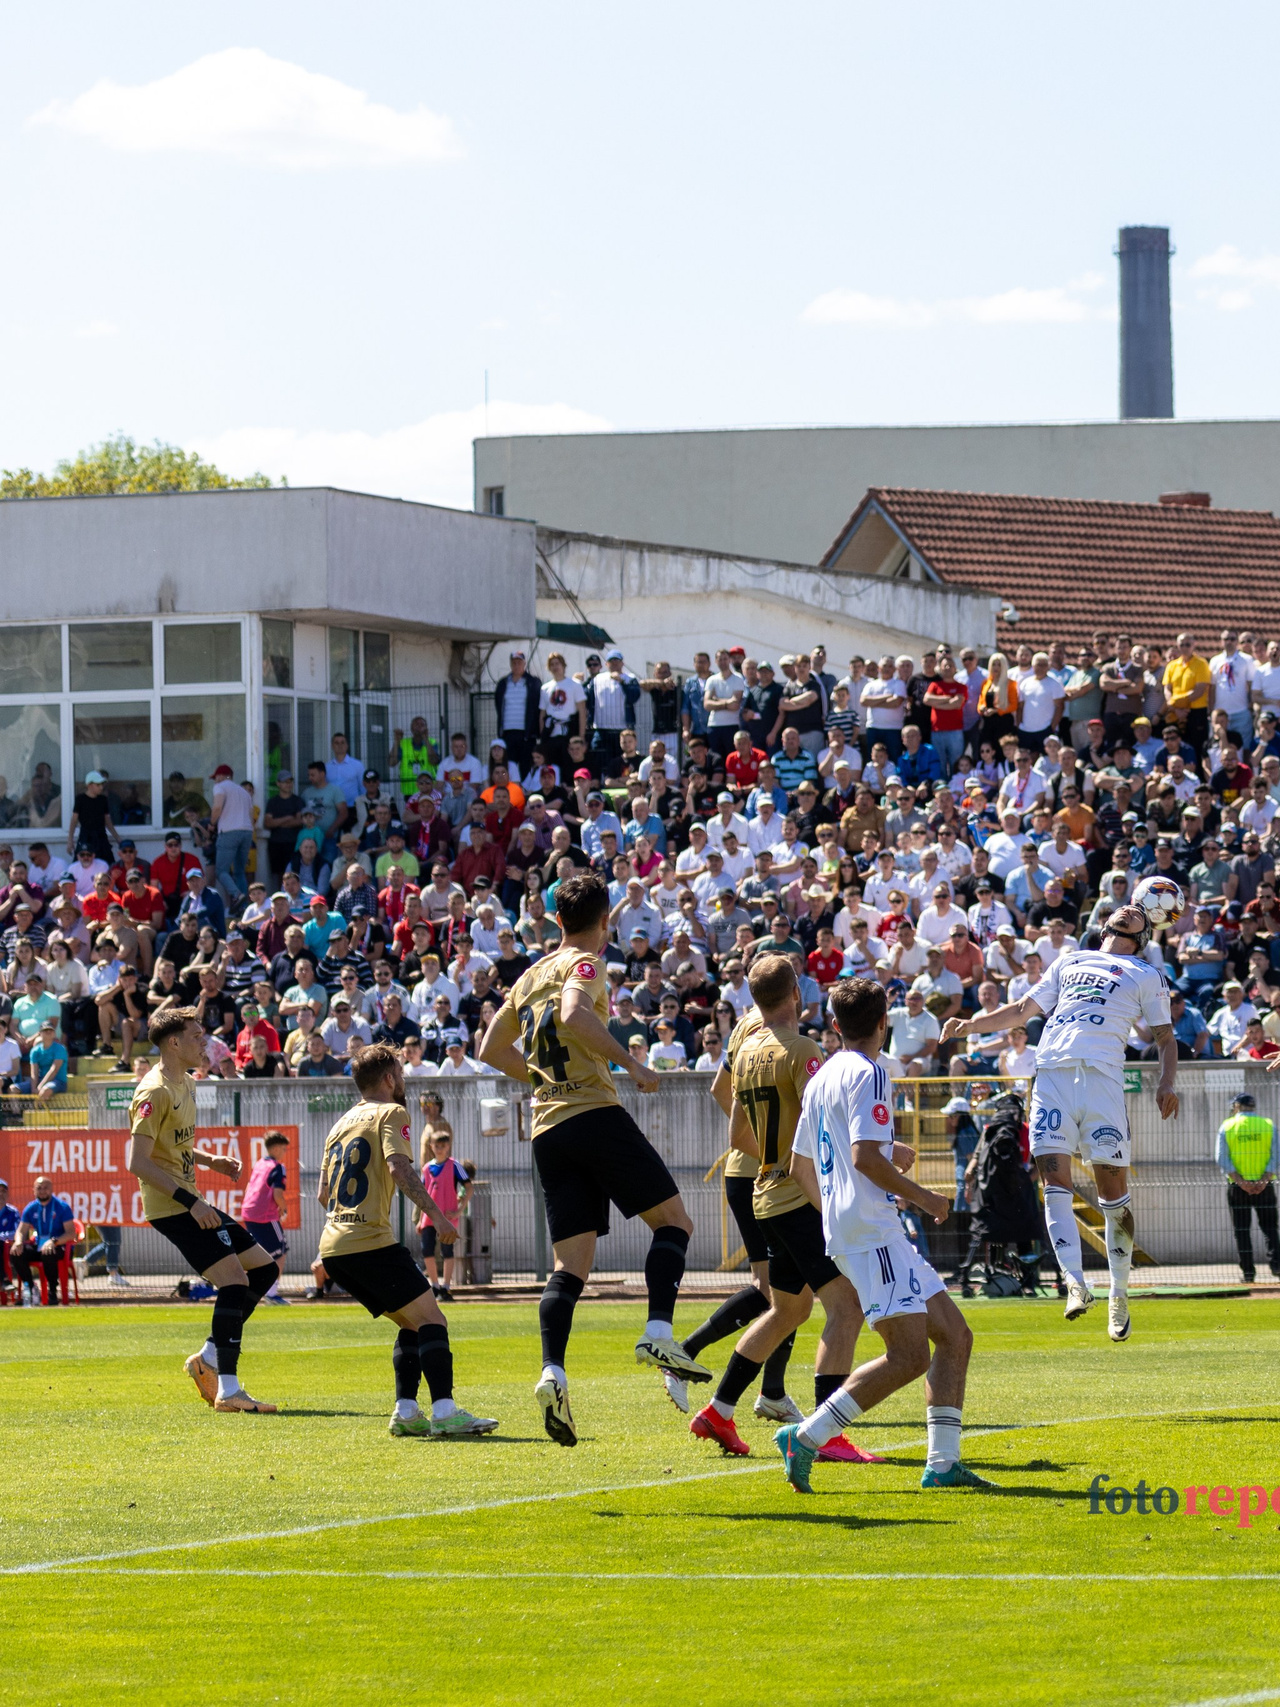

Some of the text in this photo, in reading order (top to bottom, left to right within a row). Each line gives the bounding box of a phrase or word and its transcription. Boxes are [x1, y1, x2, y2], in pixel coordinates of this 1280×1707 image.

[108, 1090, 134, 1100] IESIR
[1035, 1108, 1062, 1131] 20
[818, 1104, 834, 1176] 6
[27, 1139, 118, 1173] ZIARUL
[909, 1267, 921, 1295] 6
